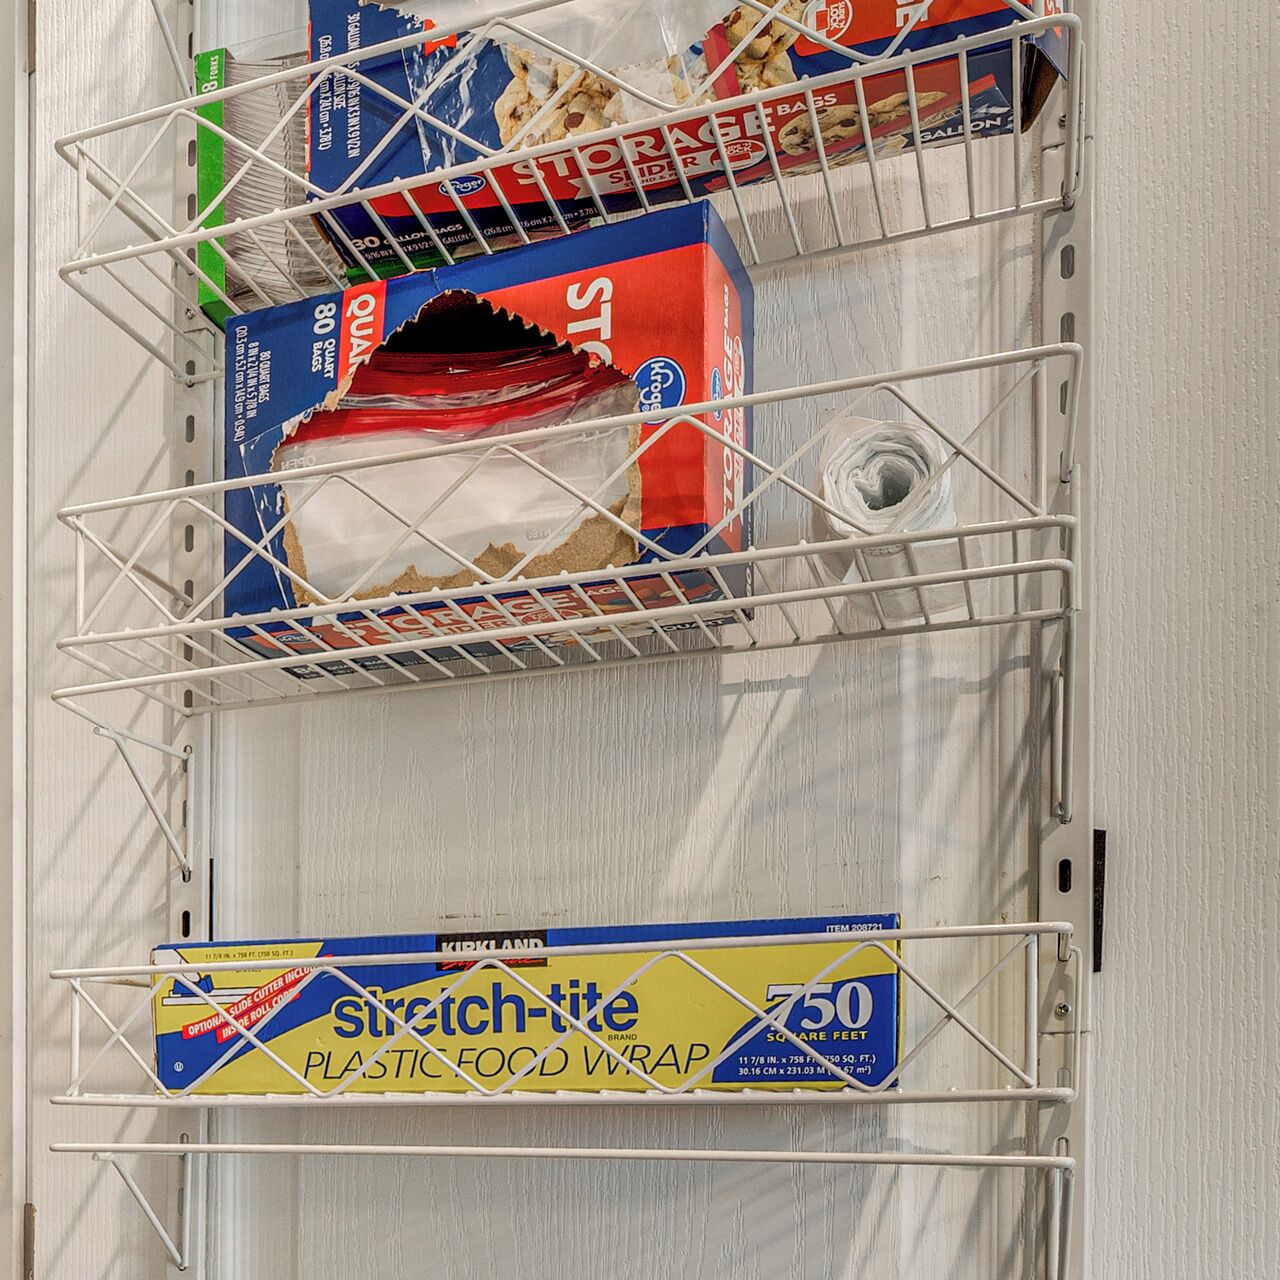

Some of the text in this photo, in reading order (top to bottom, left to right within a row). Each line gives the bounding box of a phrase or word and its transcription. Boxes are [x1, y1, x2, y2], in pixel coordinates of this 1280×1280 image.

[347, 23, 360, 49] GALLON
[201, 54, 220, 93] 8 FORKS
[333, 72, 346, 95] ALLON
[513, 93, 838, 184] STORAGE BAGS
[351, 236, 380, 251] 30
[313, 302, 337, 379] 80 QUART
[311, 341, 324, 373] BAGS
[257, 351, 271, 403] 80 QUART BAGS
[826, 923, 884, 933] ITEM 208721
[440, 937, 545, 954] KIRKLAND
[187, 978, 285, 1036] OPTIONA SLIDE CUTTER
[221, 1005, 271, 1039] INSDE ROLL
[333, 979, 640, 1040] stretch-tite
[765, 981, 874, 1031] 750
[607, 1033, 638, 1042] BRAND
[766, 1030, 868, 1043] SQARE FEET
[304, 1042, 711, 1081] PLASTIC FOOD WRAP
[738, 1056, 749, 1065] 11
[751, 1056, 765, 1065] 7/8
[766, 1056, 780, 1065] IN.
[789, 1055, 804, 1064] 758
[842, 1054, 858, 1064] SQ.
[859, 1054, 877, 1064] FT.)
[738, 1066, 761, 1076] 30.16
[762, 1066, 778, 1076] CM
[786, 1066, 815, 1076] 231.03
[816, 1066, 826, 1075] M
